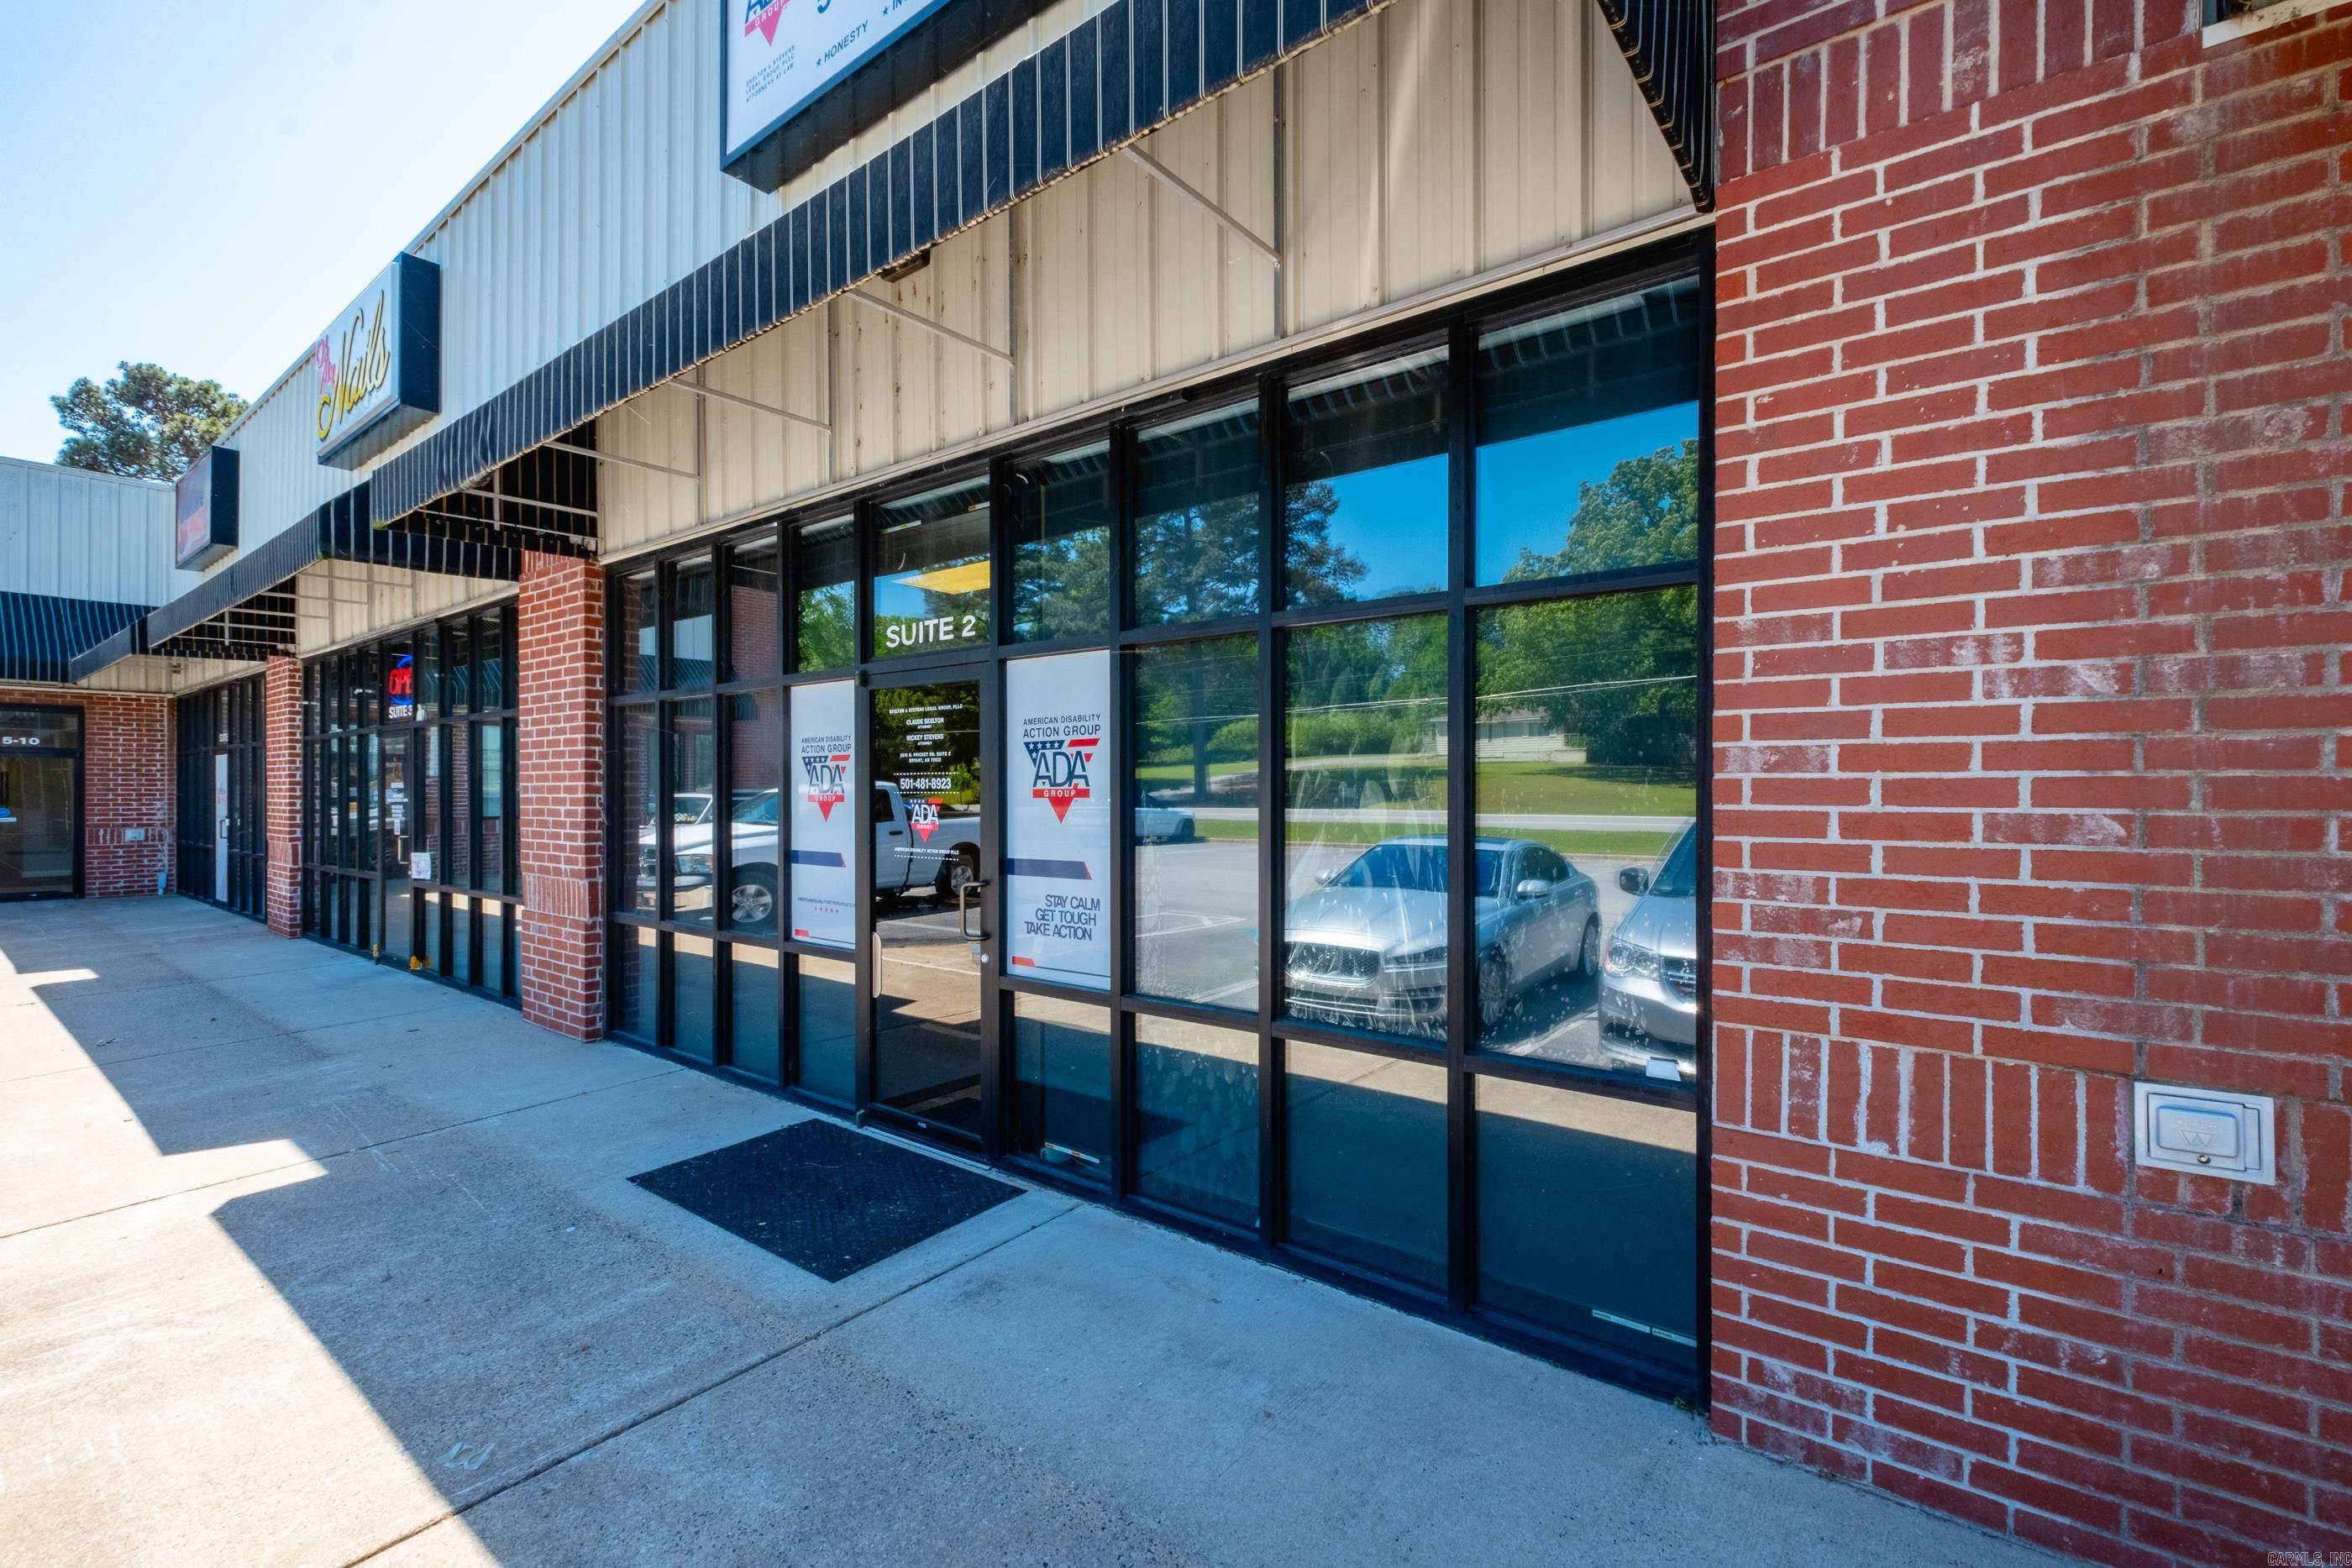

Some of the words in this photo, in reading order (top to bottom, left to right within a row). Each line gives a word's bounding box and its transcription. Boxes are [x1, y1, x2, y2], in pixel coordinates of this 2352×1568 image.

[824, 19, 868, 63] HONESTY
[318, 289, 390, 442] Nails
[886, 616, 954, 648] SUITE
[961, 615, 976, 637] 2
[389, 667, 412, 695] OPE
[388, 705, 407, 719] SUITE
[407, 705, 412, 716] 3
[1023, 716, 1058, 726] AMERICAN
[1061, 714, 1100, 723] DISABILITY
[1023, 726, 1059, 738] ACTION
[1063, 724, 1100, 736] GROUP
[2, 737, 39, 745] 5-10
[801, 745, 825, 753] ACTION
[827, 743, 851, 753] GROUP
[1032, 750, 1090, 788] ADA
[809, 764, 844, 794] ADA
[900, 778, 951, 789] 501-481-8923
[911, 804, 939, 825] ADA
[1045, 894, 1068, 909] STAY
[1070, 896, 1100, 911] CALM
[1036, 908, 1056, 922] GET
[1058, 910, 1096, 926] TOUGH
[1024, 920, 1051, 936] TAKE
[1053, 924, 1092, 941] ACTION
